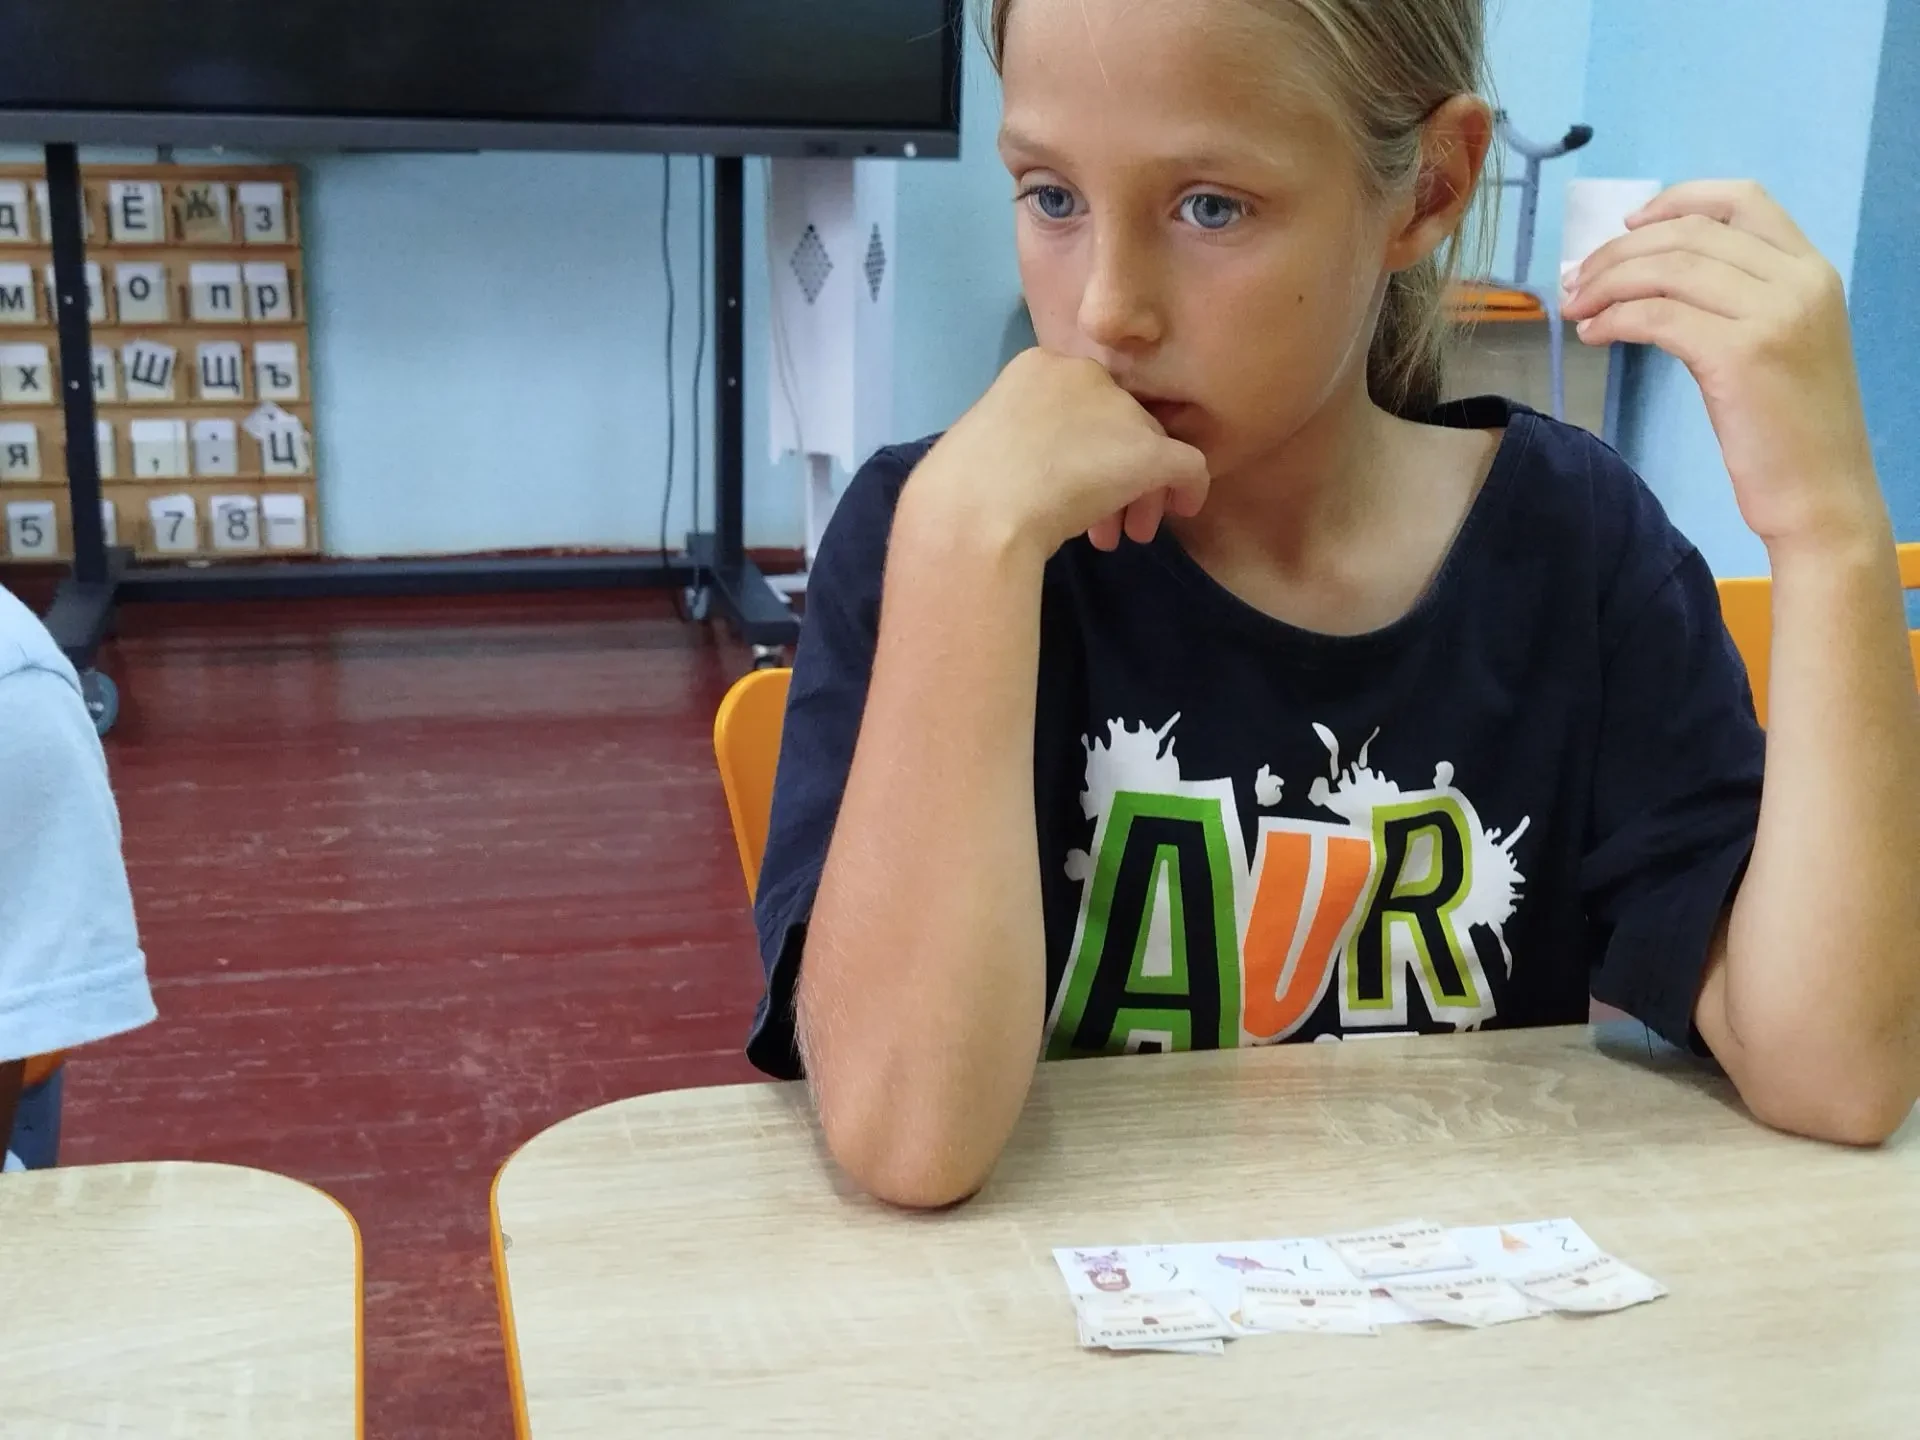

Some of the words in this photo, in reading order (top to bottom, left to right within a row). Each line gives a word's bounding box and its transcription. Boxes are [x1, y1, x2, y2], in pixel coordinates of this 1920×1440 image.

[122, 184, 147, 230] Ё
[19, 515, 44, 548] 5
[164, 511, 185, 544] 7
[227, 507, 250, 541] 8
